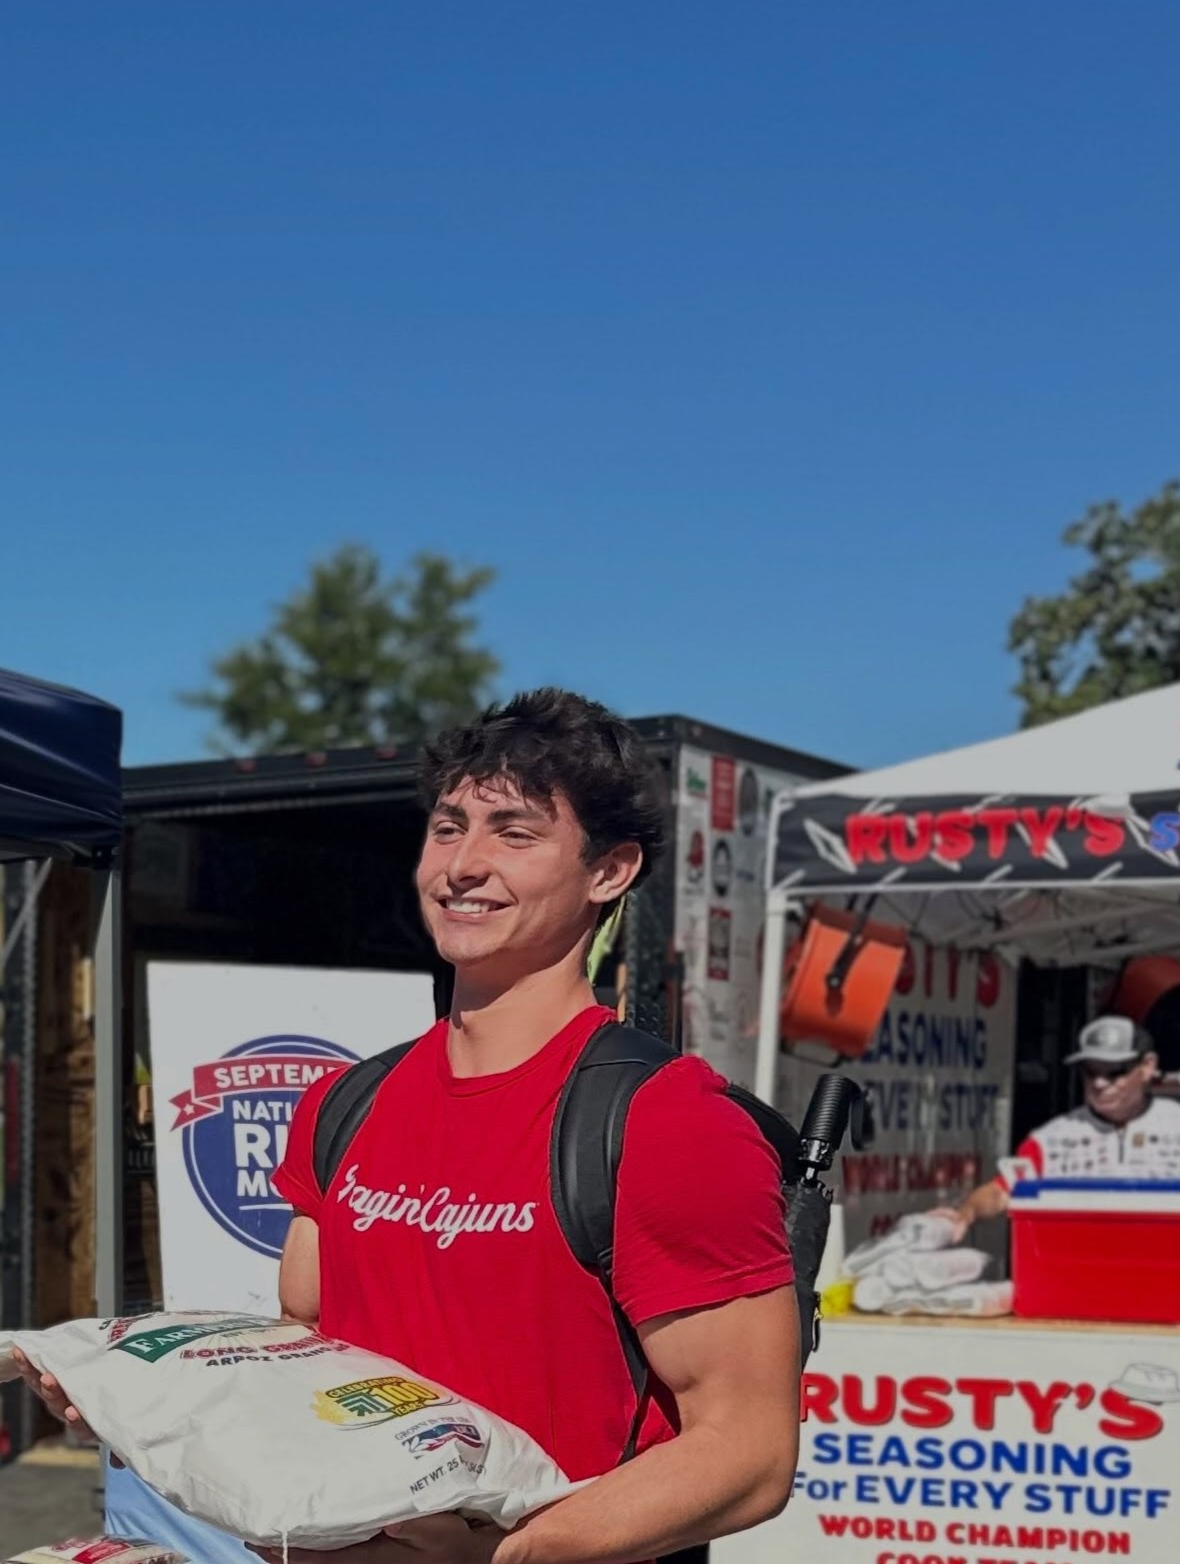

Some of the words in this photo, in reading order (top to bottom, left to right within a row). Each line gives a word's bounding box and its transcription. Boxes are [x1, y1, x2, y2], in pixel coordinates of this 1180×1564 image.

[845, 806, 1125, 865] RUSTY'S
[214, 1063, 335, 1088] SEPTEM
[232, 1099, 293, 1122] NATI
[234, 1123, 289, 1169] RI
[420, 1187, 537, 1249] Cajuns
[369, 1381, 440, 1408] 100
[799, 1373, 1165, 1441] RUSTY'S
[409, 1475, 431, 1495] NET
[447, 1457, 460, 1472] 25
[813, 1432, 1133, 1480] SEASONING
[855, 1474, 1014, 1511] EVERY
[1023, 1483, 1172, 1520] STUFF
[818, 1514, 937, 1543] WORLD
[945, 1521, 1131, 1556] CHAMPION
